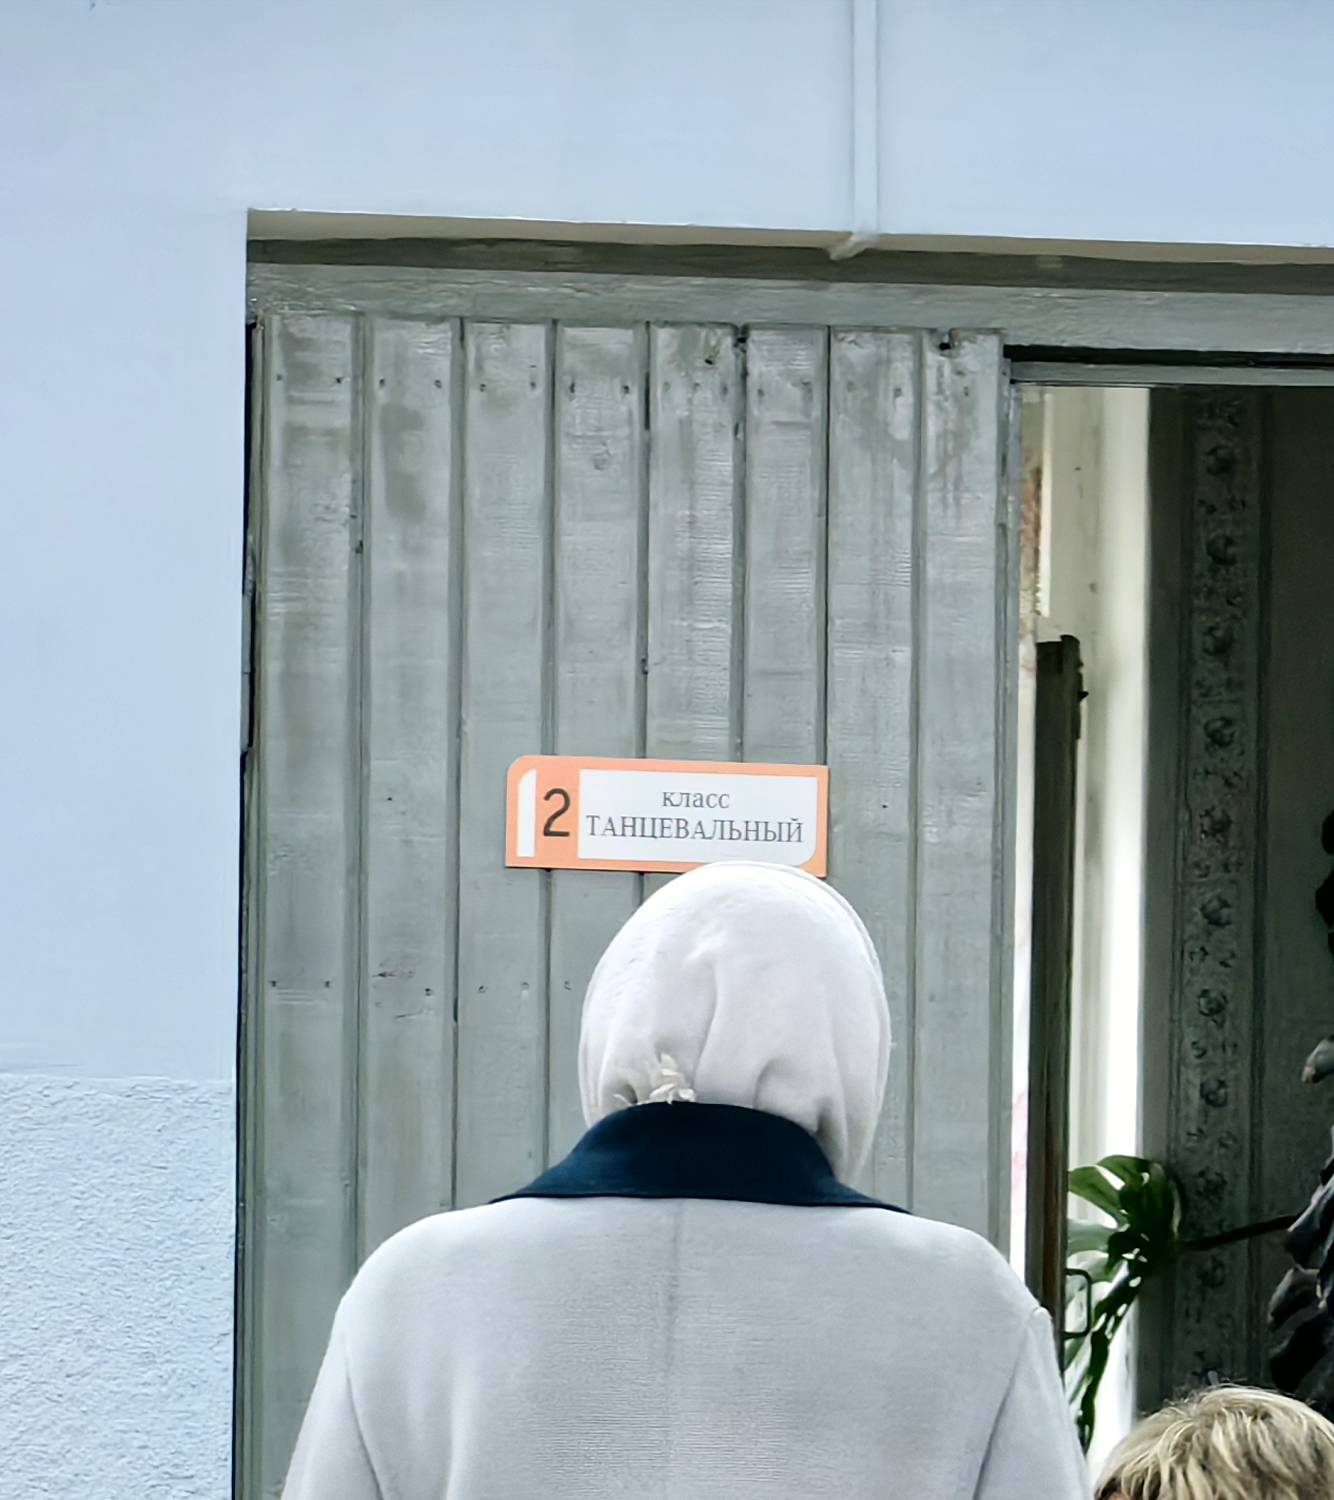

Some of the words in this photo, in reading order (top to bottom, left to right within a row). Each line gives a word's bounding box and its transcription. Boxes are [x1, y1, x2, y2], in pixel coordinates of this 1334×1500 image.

[542, 787, 571, 838] 2
[661, 790, 731, 809] класс
[585, 814, 804, 843] ТАНЦЕВАЛЬНЫЙ
